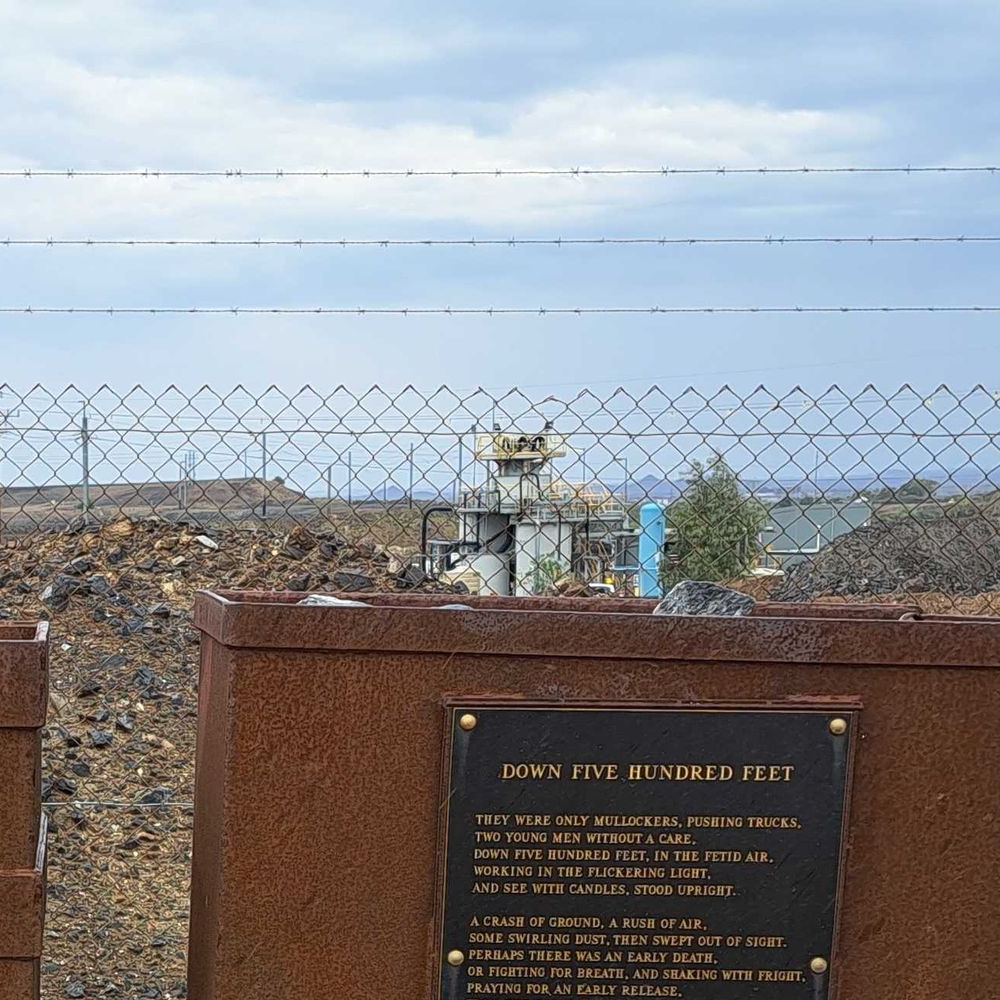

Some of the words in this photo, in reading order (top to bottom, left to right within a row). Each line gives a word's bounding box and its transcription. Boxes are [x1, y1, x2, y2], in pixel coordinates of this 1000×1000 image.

[501, 764, 562, 778] DOWN
[571, 764, 618, 779] FIVE
[627, 765, 733, 780] HUNDRED
[741, 766, 795, 781] FEET
[475, 814, 510, 826] THEY
[514, 814, 551, 826] WERE
[555, 815, 590, 827] ONLY
[687, 816, 743, 828] PUSHING
[474, 832, 501, 844] TWO
[505, 832, 547, 844] YOUNG
[552, 832, 581, 844] MEN
[586, 833, 643, 845] WITHOUT
[645, 833, 655, 845] A
[474, 849, 509, 861] DOWN
[514, 849, 543, 861] FIVE
[547, 850, 610, 862] HUNDRED
[654, 850, 669, 862] IN
[673, 851, 700, 862] THE
[703, 851, 742, 863] FETID
[473, 866, 533, 878] WORKING
[537, 866, 552, 878] IN
[557, 866, 583, 878] THE
[587, 867, 666, 879] FLICKERING
[472, 883, 499, 895] AND
[503, 884, 528, 895] SEE
[532, 884, 564, 896] WITH
[634, 885, 674, 897] STOOD
[471, 916, 480, 928] A
[483, 916, 525, 928] CRASH
[529, 916, 546, 929] OF
[608, 917, 619, 930] A
[622, 918, 656, 930] RUSH
[660, 918, 677, 930] OF
[468, 932, 504, 945] SOME
[508, 933, 571, 945] SWIRLING
[613, 934, 648, 947] THEN
[652, 935, 693, 947] SWEPT
[697, 935, 723, 948] OUT
[726, 936, 743, 948] OF
[468, 950, 525, 962] PERHAPS
[529, 950, 572, 963] THERE
[575, 951, 601, 963] WAS
[604, 951, 623, 963] AN
[627, 952, 669, 964] EARLY
[467, 966, 485, 978] OR
[488, 966, 546, 979] FIGHTING
[550, 967, 573, 979] FOR
[632, 968, 659, 980] AND
[662, 969, 718, 981] SHAKING
[722, 969, 753, 982] WITH
[466, 983, 522, 995] PRAYING
[526, 983, 550, 996] FOR
[554, 984, 572, 996] AN
[577, 984, 617, 997] EARLY
